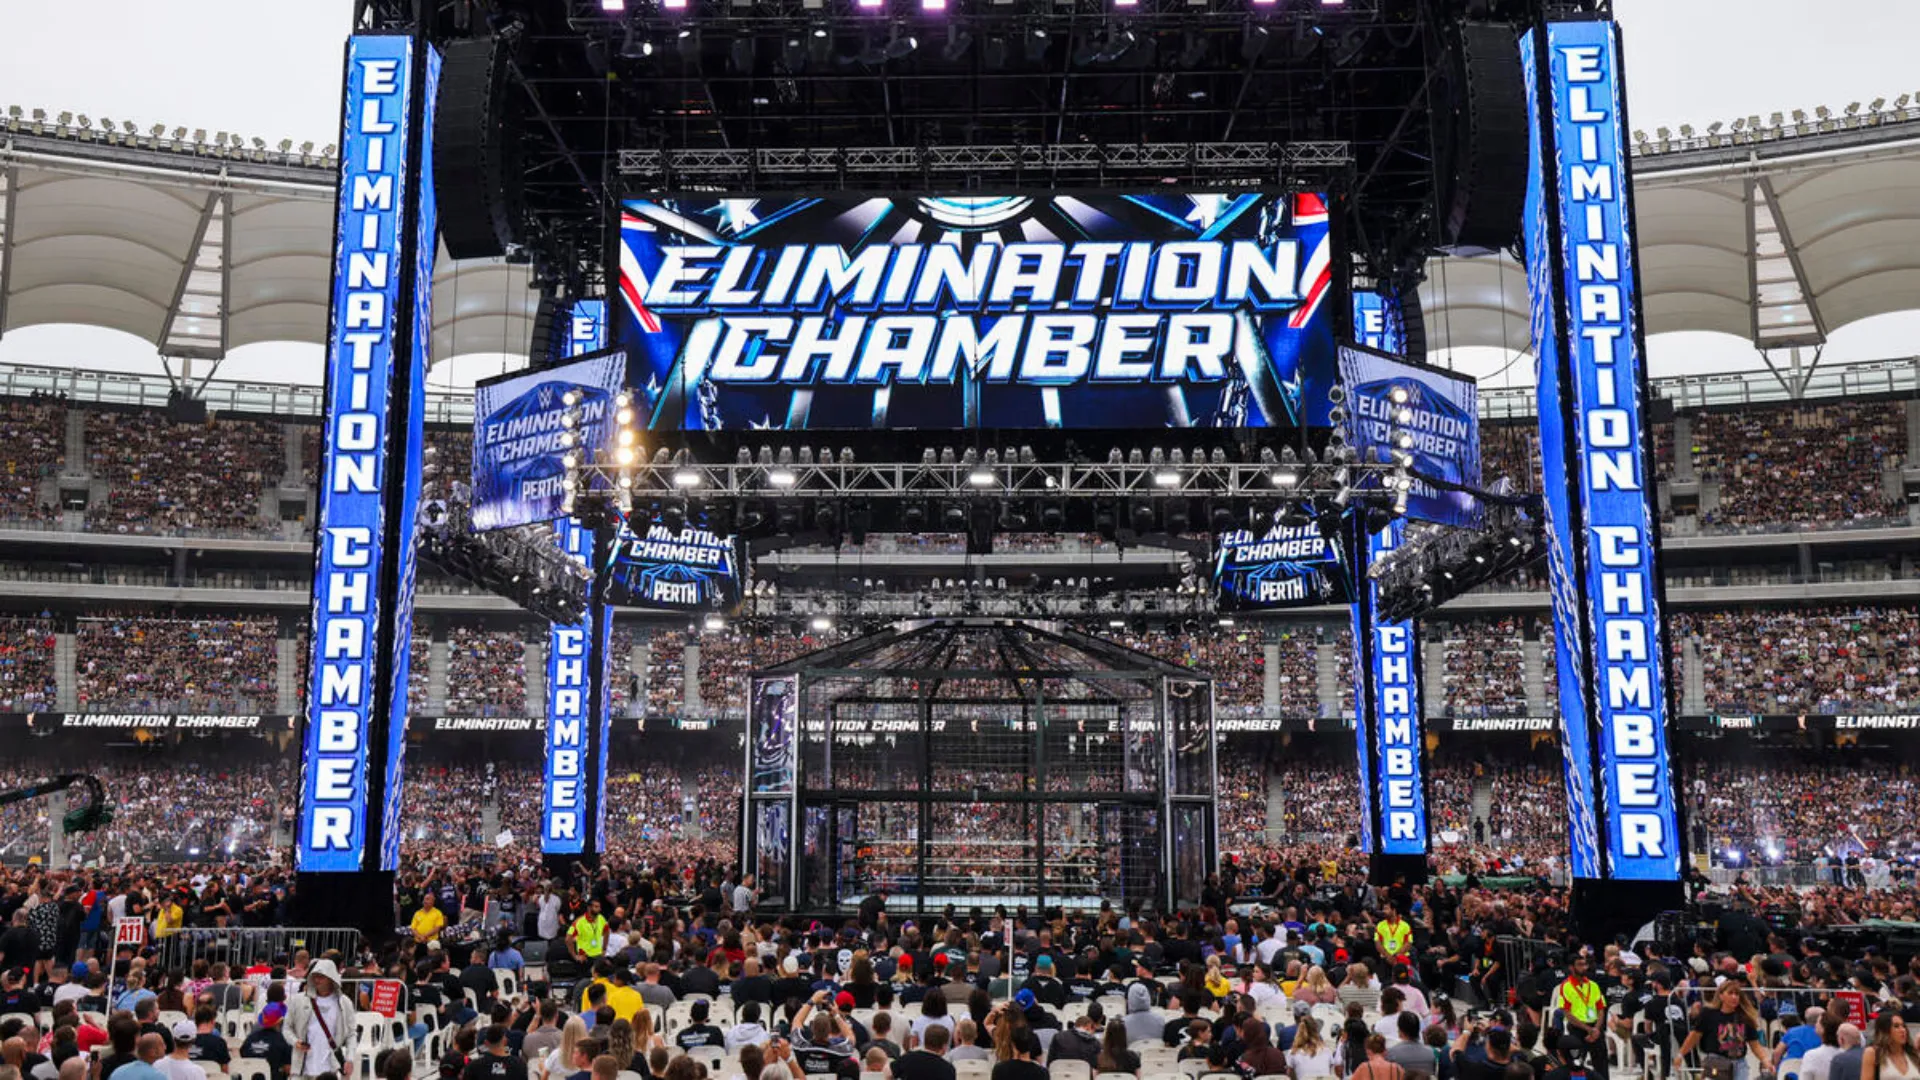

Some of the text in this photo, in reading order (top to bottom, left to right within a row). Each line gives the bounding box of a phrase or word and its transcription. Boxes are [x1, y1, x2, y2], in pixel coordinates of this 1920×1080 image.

[645, 240, 1302, 305] ELIMINATION
[708, 313, 1238, 384] CHAMBER
[486, 399, 605, 444] ELIMINAON
[1358, 394, 1467, 440] ELINATION
[311, 59, 399, 848] ELIMINATION CHAMBER
[499, 426, 588, 462] CHAMBR
[1558, 46, 1664, 857] ELIMINATION CHAMBER
[630, 540, 721, 565] CHAMBER
[1235, 538, 1326, 562] CHAMBER
[653, 579, 698, 604] PERTH
[1260, 577, 1304, 602] PERTH
[62, 714, 260, 728] ELIMINATION CHAMBER
[434, 718, 532, 730] ELIMINATION
[1216, 720, 1282, 731] HAMBER
[1377, 627, 1417, 839] CHAMBER
[1452, 718, 1553, 730] ELIMINATION
[1720, 717, 1753, 729] PERTH
[1835, 715, 1920, 729] ELIMINAT
[550, 630, 584, 839] CHAMBER
[117, 924, 142, 942] A11
